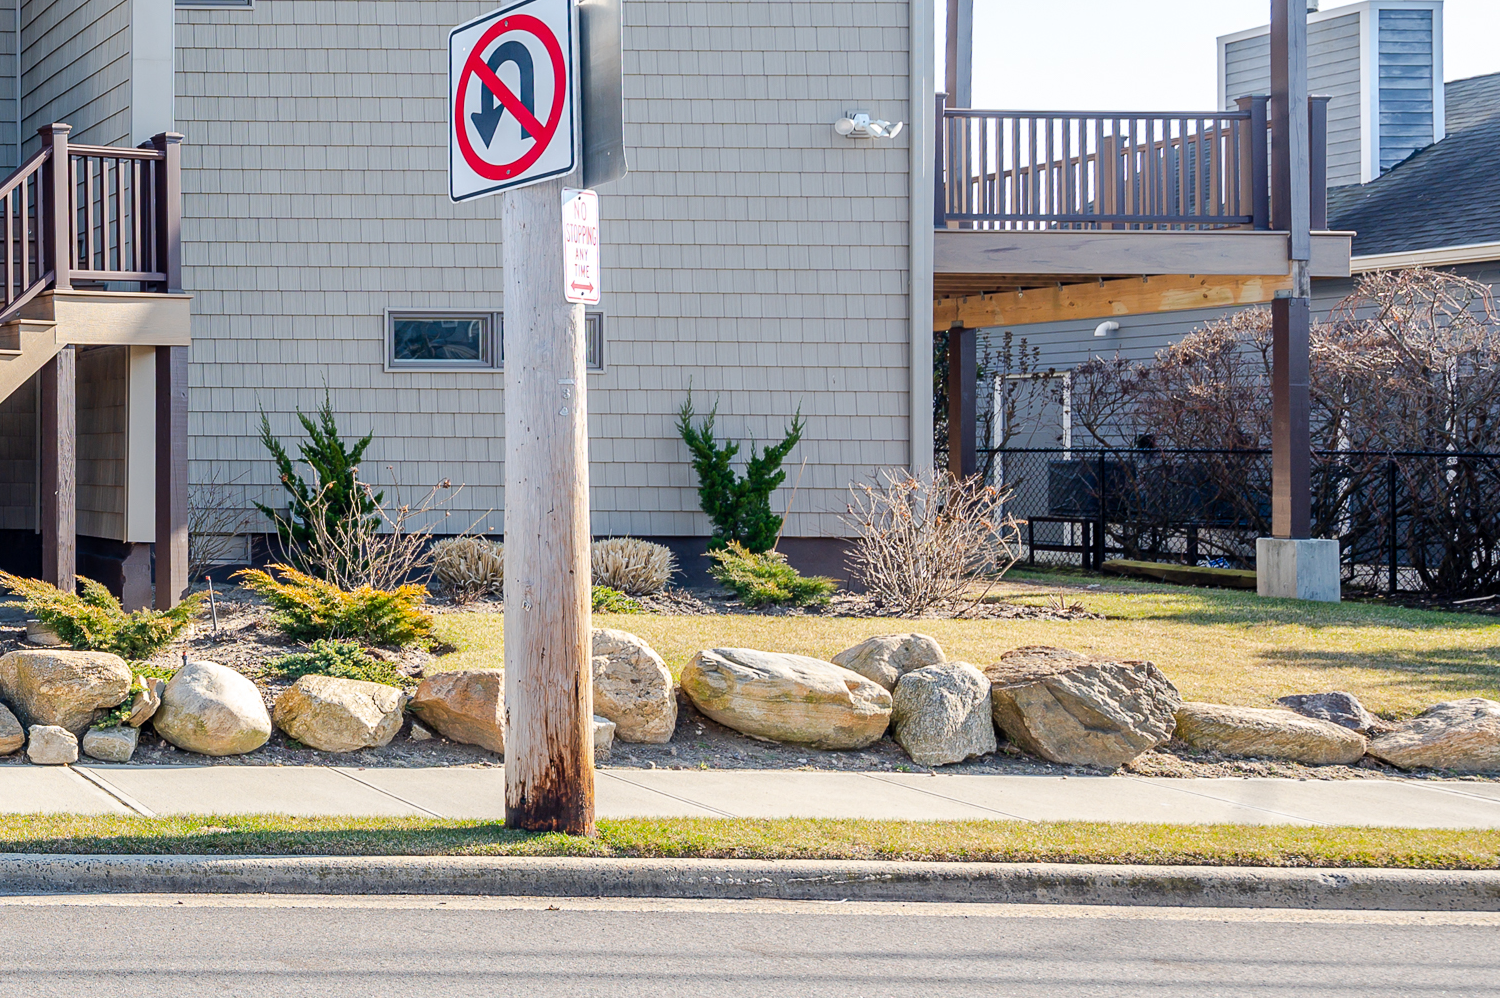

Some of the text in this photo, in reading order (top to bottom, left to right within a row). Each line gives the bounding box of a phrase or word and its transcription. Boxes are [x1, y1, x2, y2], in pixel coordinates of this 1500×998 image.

[573, 201, 587, 220] NO
[566, 223, 597, 246] STOPPING
[575, 248, 588, 261] ANY
[574, 263, 590, 279] TIME
